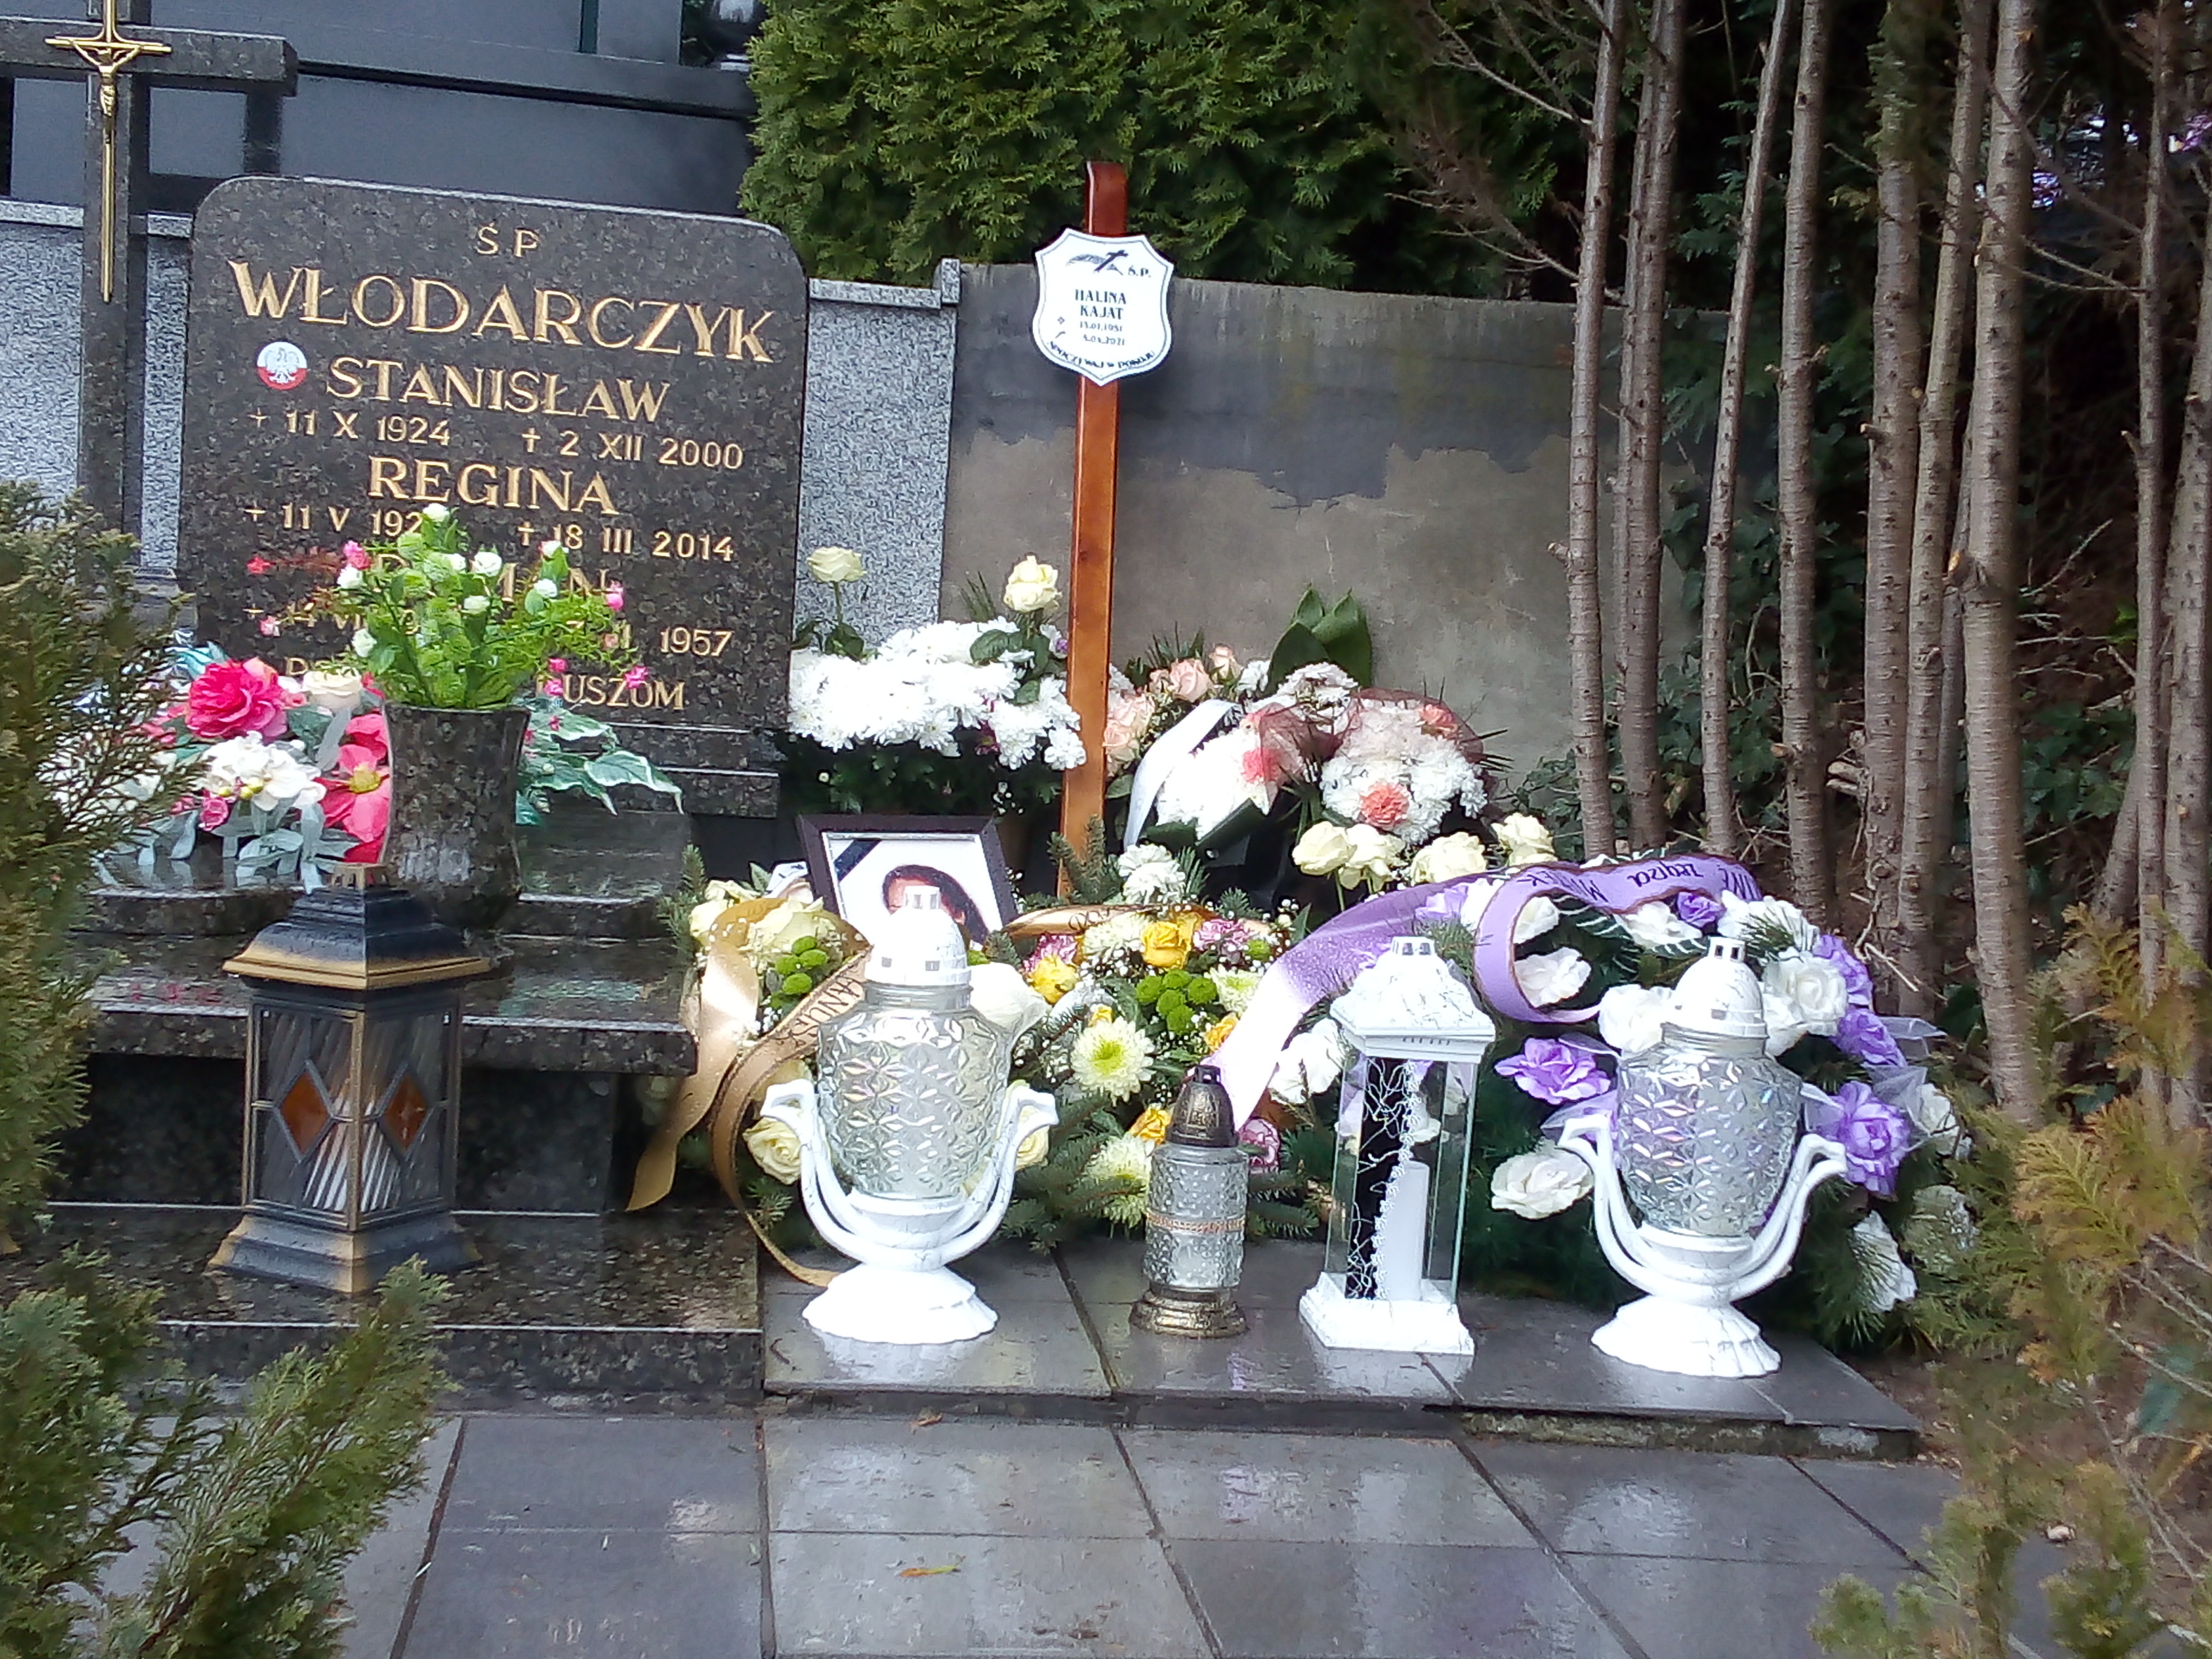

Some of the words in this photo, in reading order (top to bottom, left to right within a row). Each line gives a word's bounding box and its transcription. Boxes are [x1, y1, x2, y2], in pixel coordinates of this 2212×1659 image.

[228, 260, 774, 364] WŁODARCZYK
[1075, 289, 1126, 304] HALINA
[327, 356, 670, 424] STANISŁAW
[287, 410, 316, 435] 11
[333, 411, 358, 438] X
[377, 415, 451, 446] 1924
[560, 430, 580, 457] 2
[599, 434, 642, 463] XII
[659, 438, 744, 470] 2000
[368, 456, 619, 516] REGINA
[282, 501, 311, 530] 11
[328, 506, 350, 533] V
[372, 508, 425, 537] 192
[603, 527, 634, 554] III
[653, 531, 735, 562] 2014
[660, 627, 734, 657] 1957
